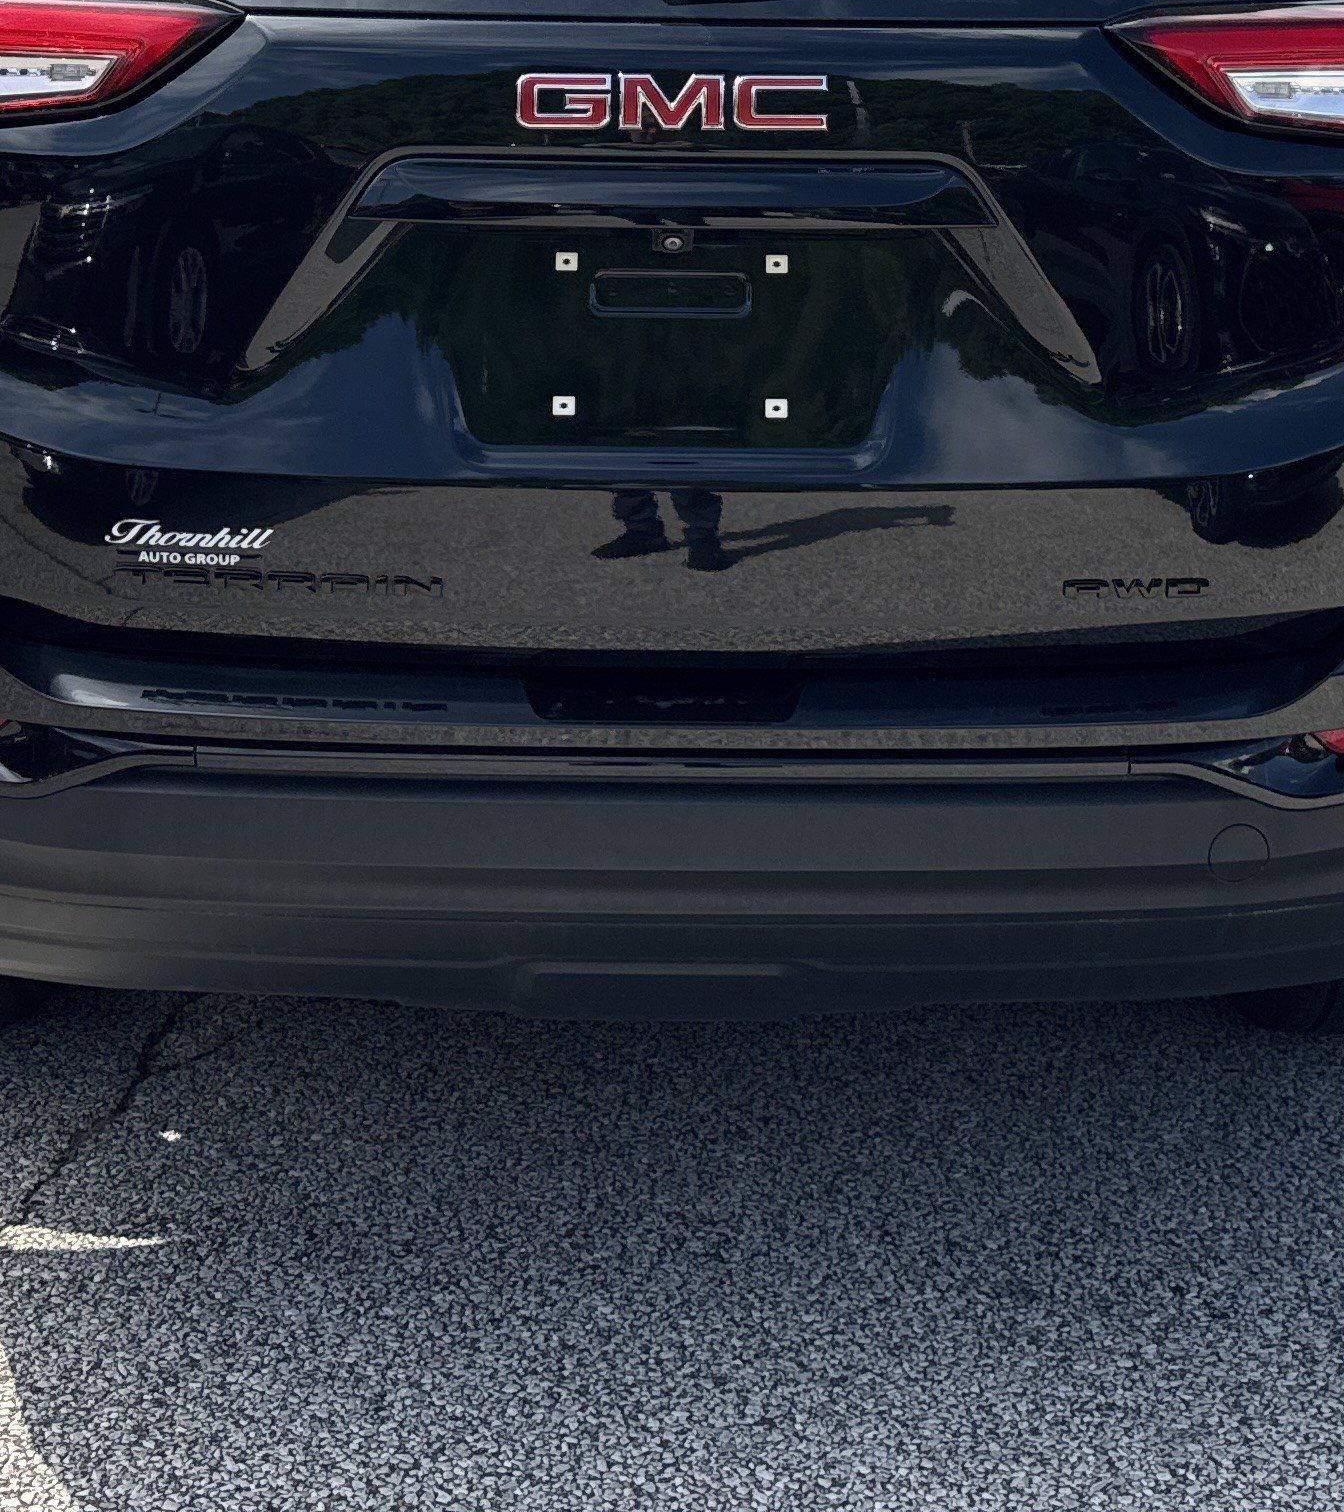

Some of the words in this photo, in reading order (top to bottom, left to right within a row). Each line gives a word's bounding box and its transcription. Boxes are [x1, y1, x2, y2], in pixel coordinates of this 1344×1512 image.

[514, 71, 830, 132] GMC
[104, 518, 275, 550] Thornhill
[138, 550, 182, 564] AUTO
[184, 553, 241, 566] GROUP
[113, 564, 445, 598] TERRAIN
[1062, 577, 1210, 599] AWD
